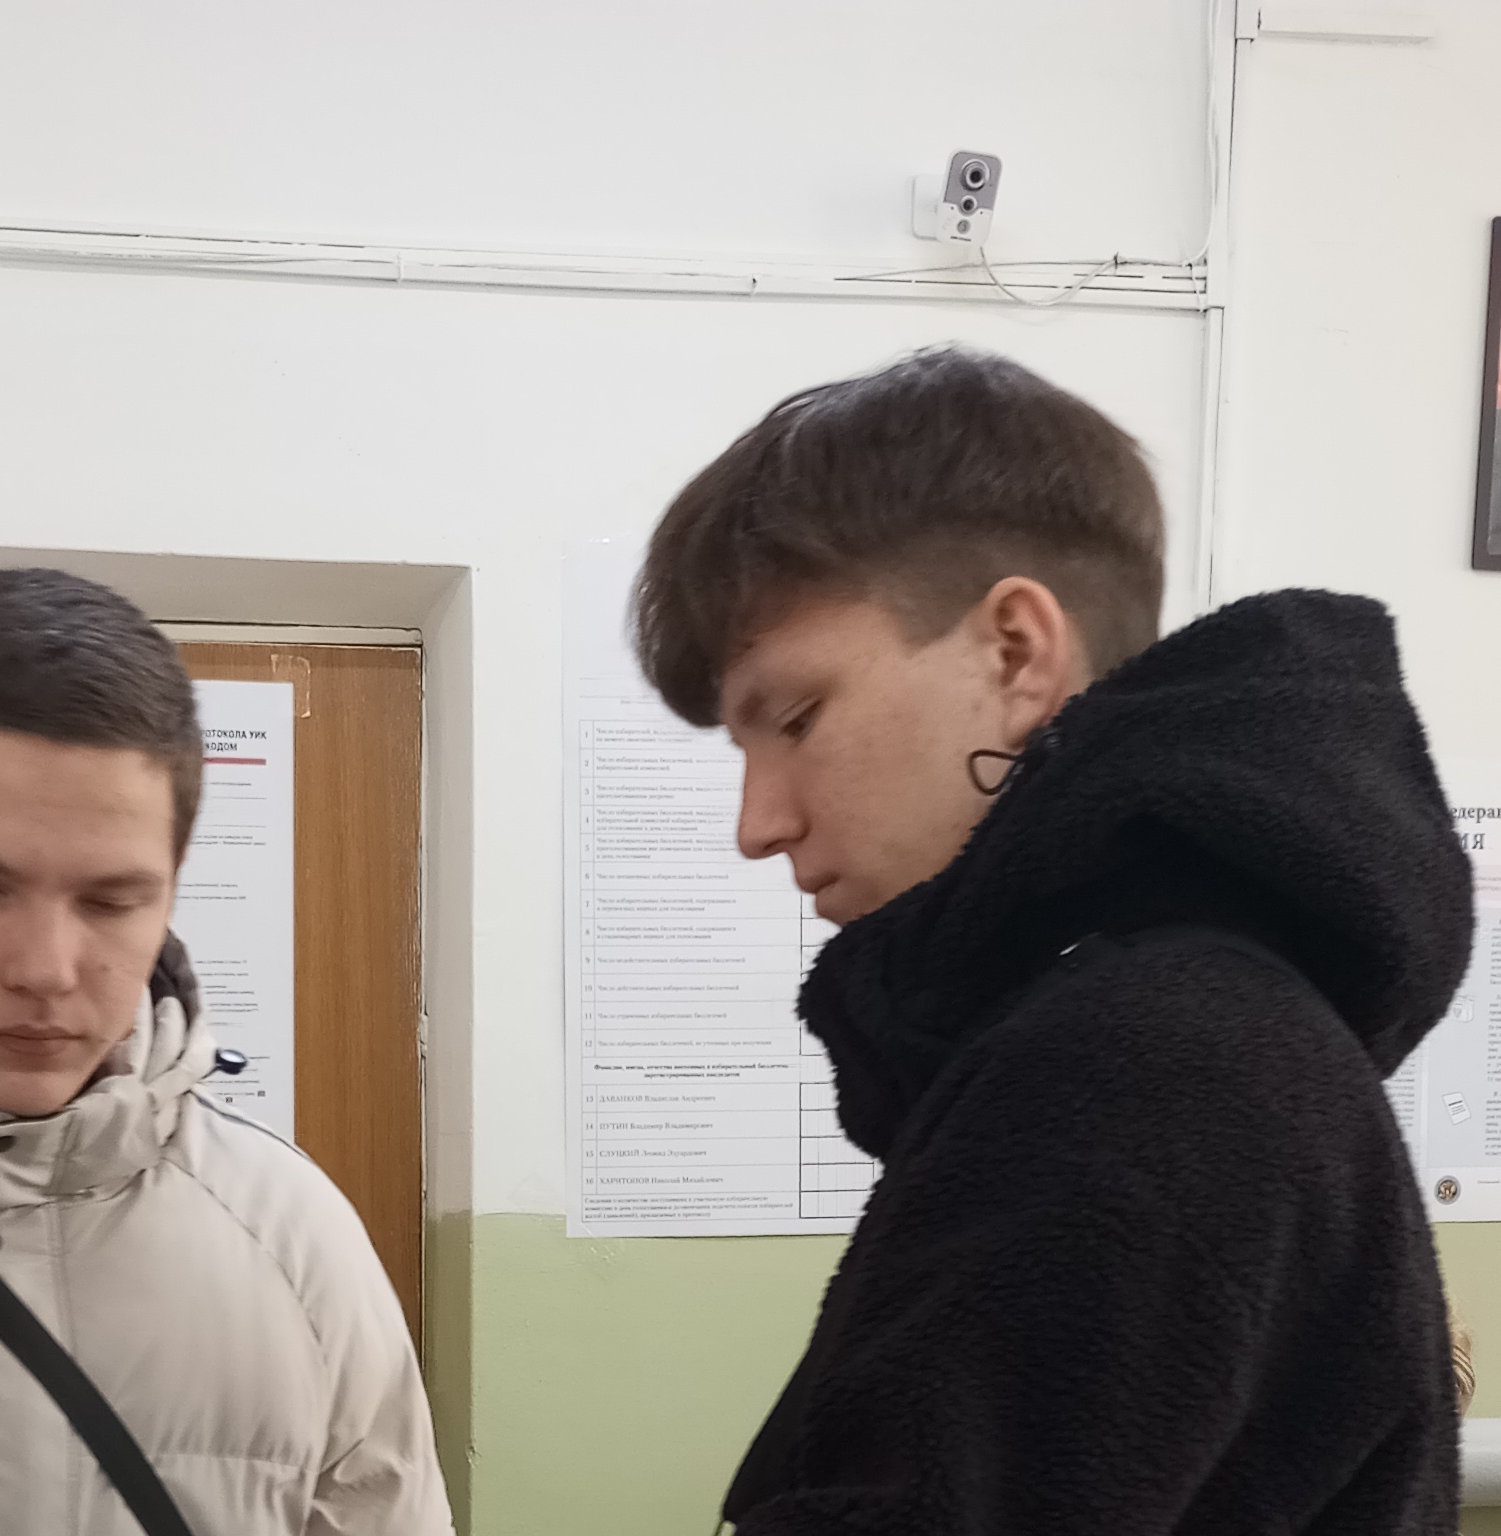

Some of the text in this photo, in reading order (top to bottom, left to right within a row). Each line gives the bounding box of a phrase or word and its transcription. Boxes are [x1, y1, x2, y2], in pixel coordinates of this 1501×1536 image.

[201, 730, 267, 739] РОТОКОЛА УИК
[1450, 807, 1501, 824] едера
[1461, 833, 1485, 849] ИЯ
[586, 1123, 593, 1131] 14
[599, 1122, 628, 1130] ПУТИН
[599, 1149, 640, 1158] СЛУЦКИЙ
